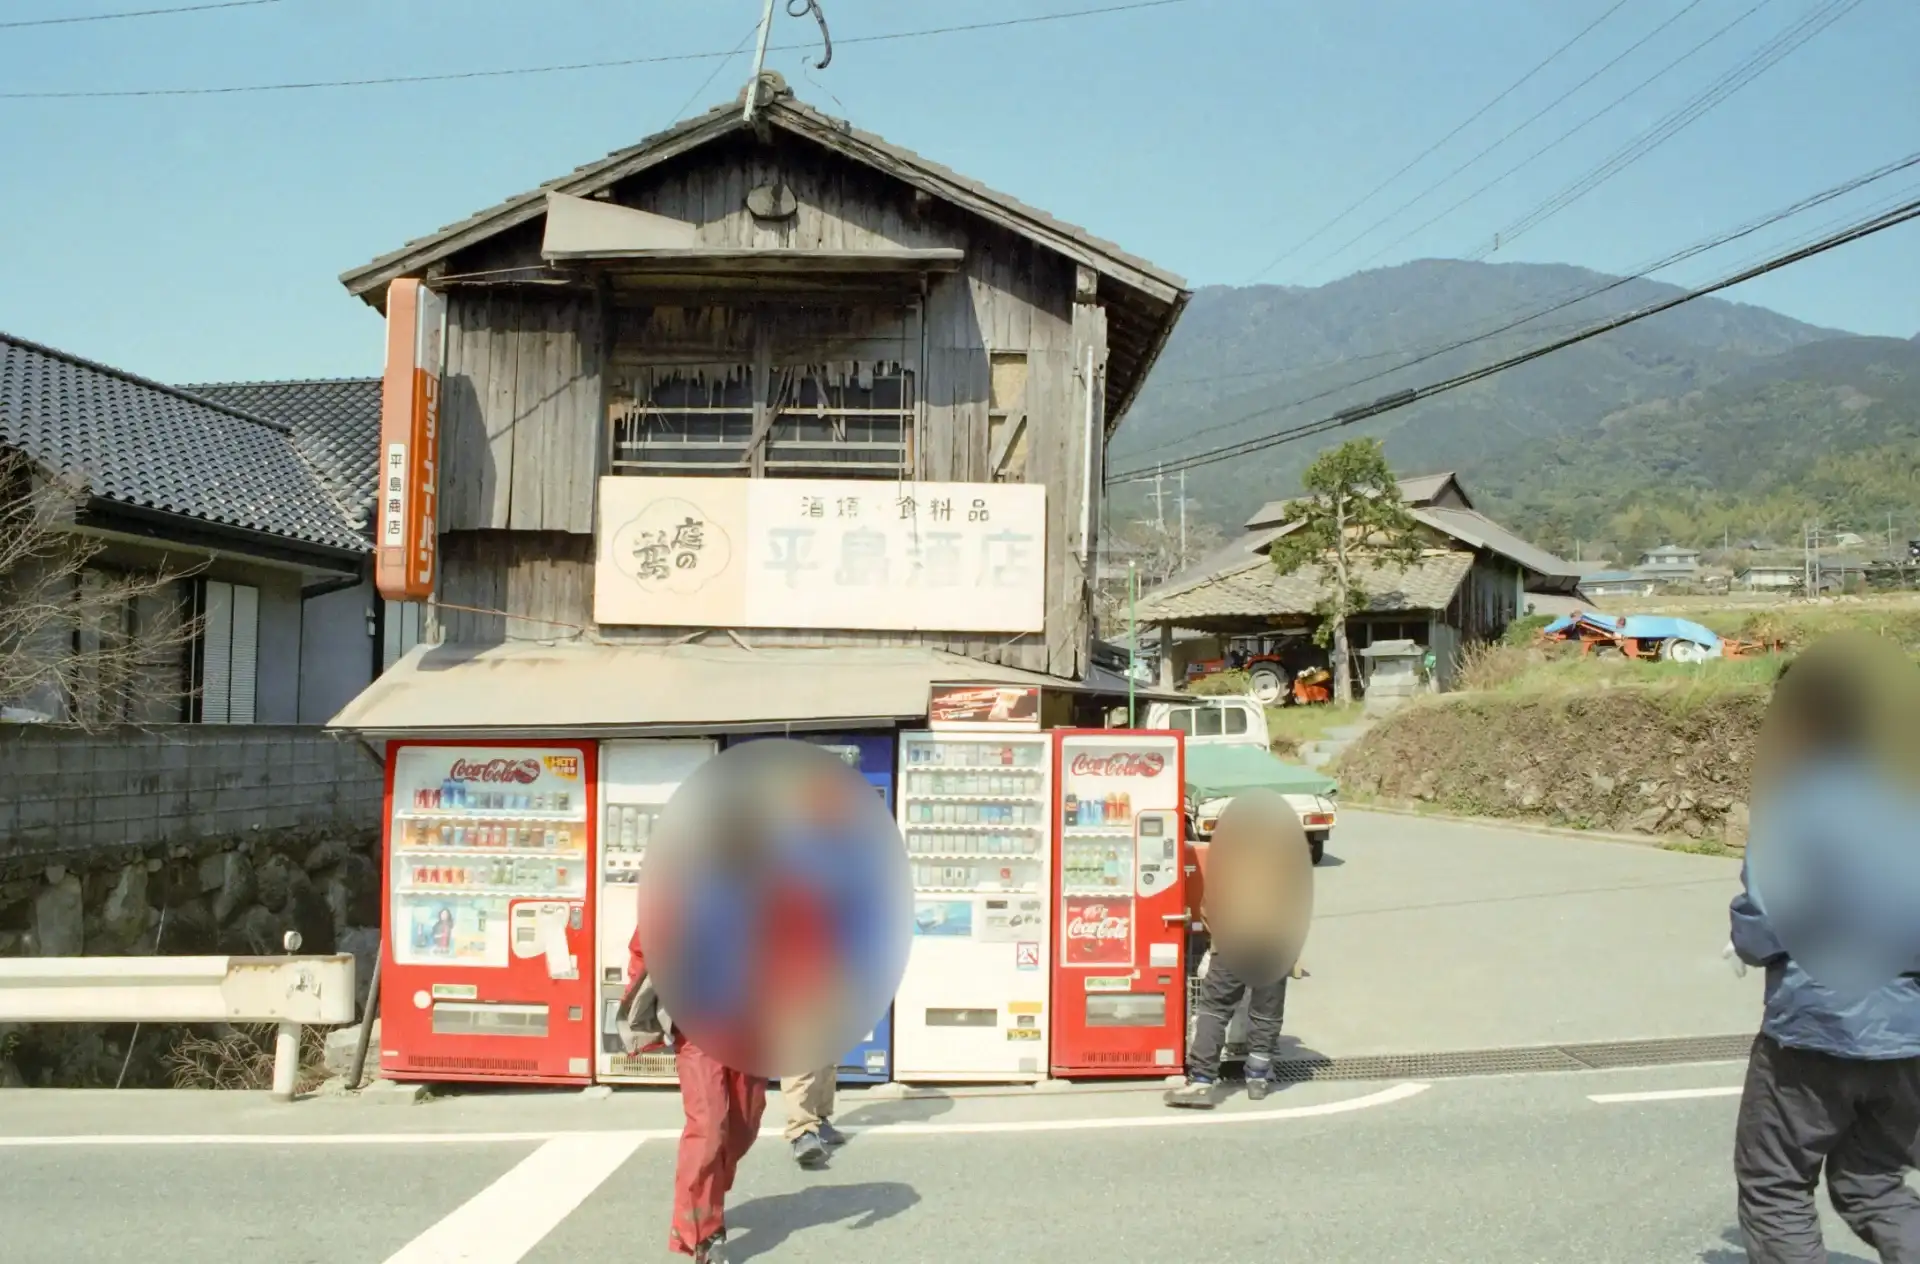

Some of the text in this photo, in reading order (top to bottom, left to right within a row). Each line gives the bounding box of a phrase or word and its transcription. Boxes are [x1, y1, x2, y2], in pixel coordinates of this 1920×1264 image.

[388, 453, 402, 535] 平島商店
[762, 525, 1034, 588] 平島酒店
[450, 758, 519, 782] Coca-Cola
[1071, 752, 1142, 776] Coca-Cola
[1068, 916, 1129, 940] Coca-Cola
